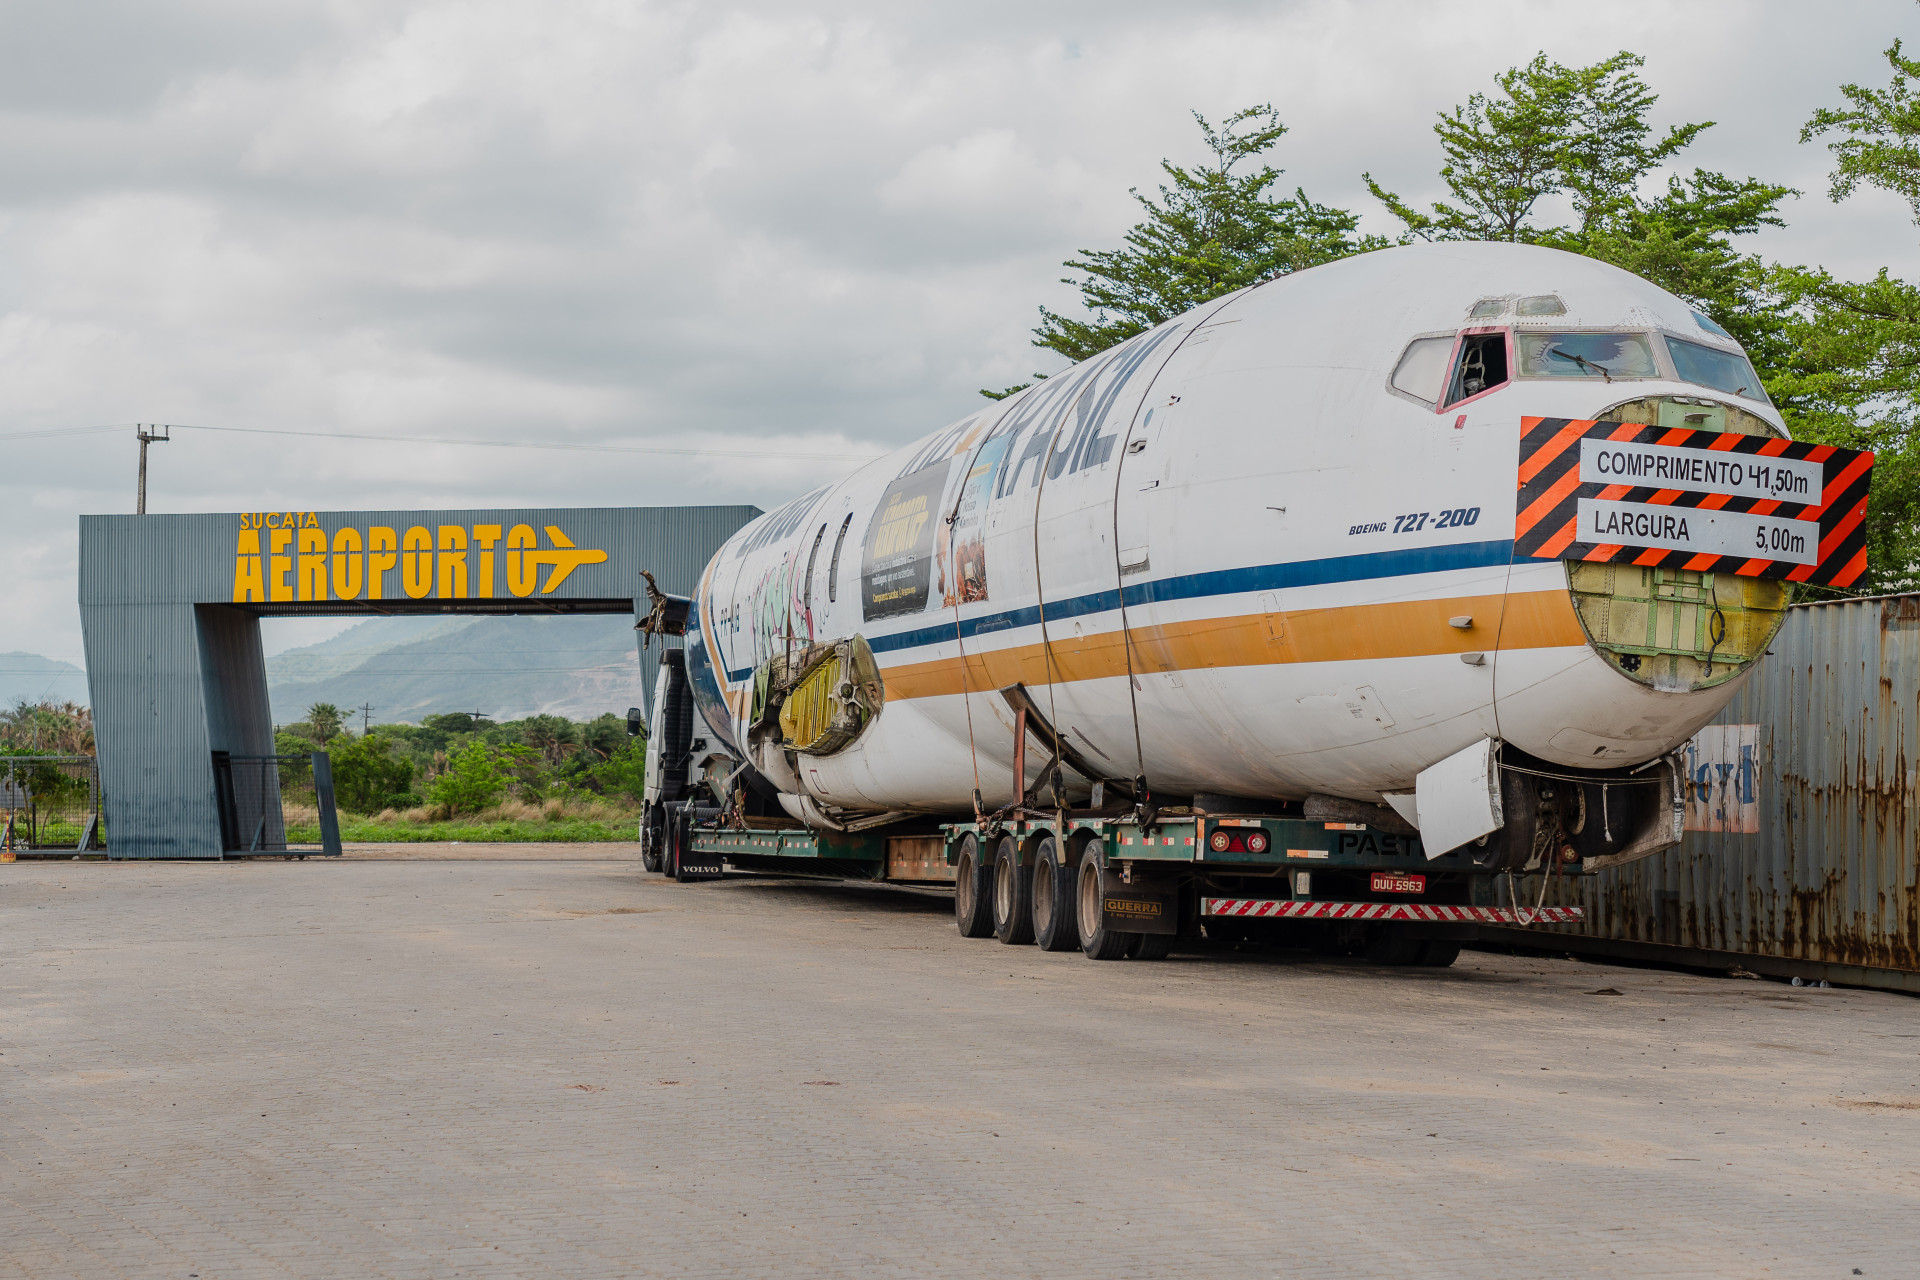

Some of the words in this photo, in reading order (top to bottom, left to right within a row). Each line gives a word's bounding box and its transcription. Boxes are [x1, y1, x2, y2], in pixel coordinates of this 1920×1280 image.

[1597, 450, 1744, 487] COMPRIMENTO
[1748, 465, 1809, 495] 41,50m
[240, 512, 319, 529] SUCATA
[1348, 522, 1387, 536] BOEING
[1392, 507, 1481, 534] 727-200
[1594, 511, 1690, 542] LARGURA
[1755, 525, 1805, 554] 5,00m
[233, 523, 537, 603] AEROPORTO
[1674, 745, 1755, 820] loyd
[1107, 901, 1158, 913] GUERRA
